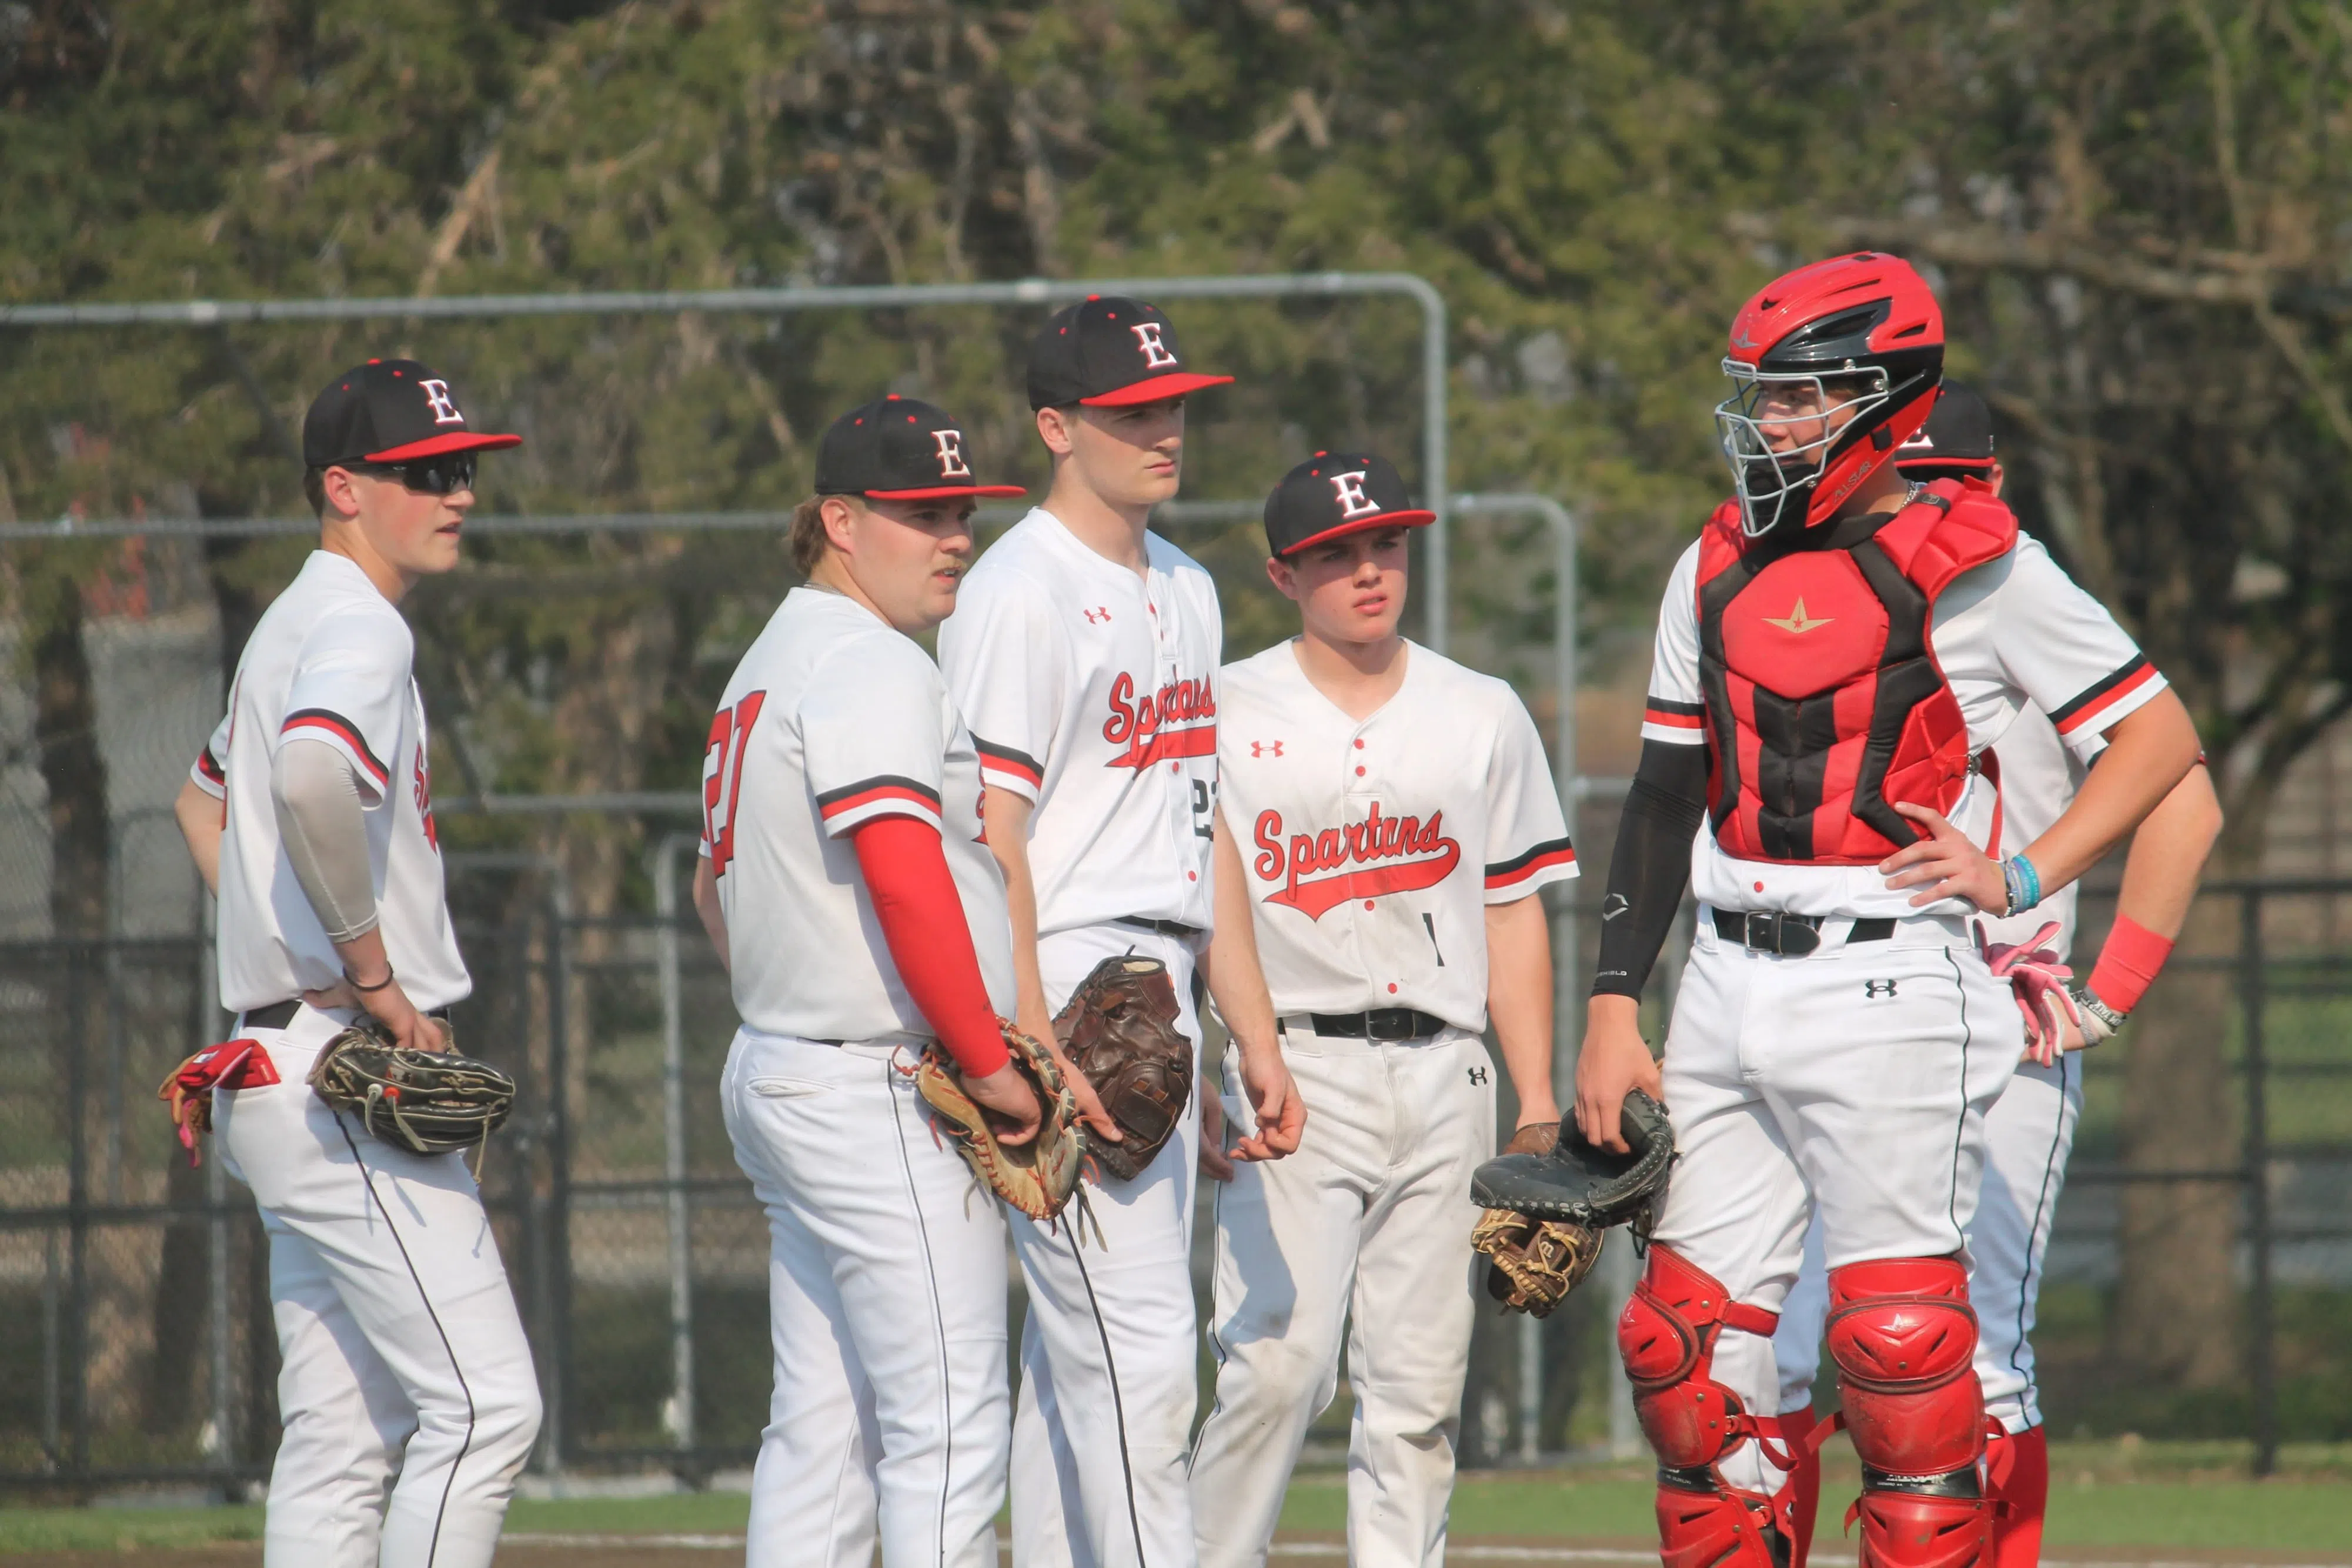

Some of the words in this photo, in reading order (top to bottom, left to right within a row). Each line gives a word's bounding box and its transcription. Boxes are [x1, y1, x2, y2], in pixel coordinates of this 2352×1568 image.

[1130, 322, 1178, 369] E
[417, 379, 463, 424] E
[930, 429, 970, 478] E
[1329, 470, 1380, 518] E
[1103, 664, 1216, 761] Spartans
[706, 690, 767, 880] 21
[1254, 801, 1444, 902] Spartans
[1422, 912, 1445, 967] 1
